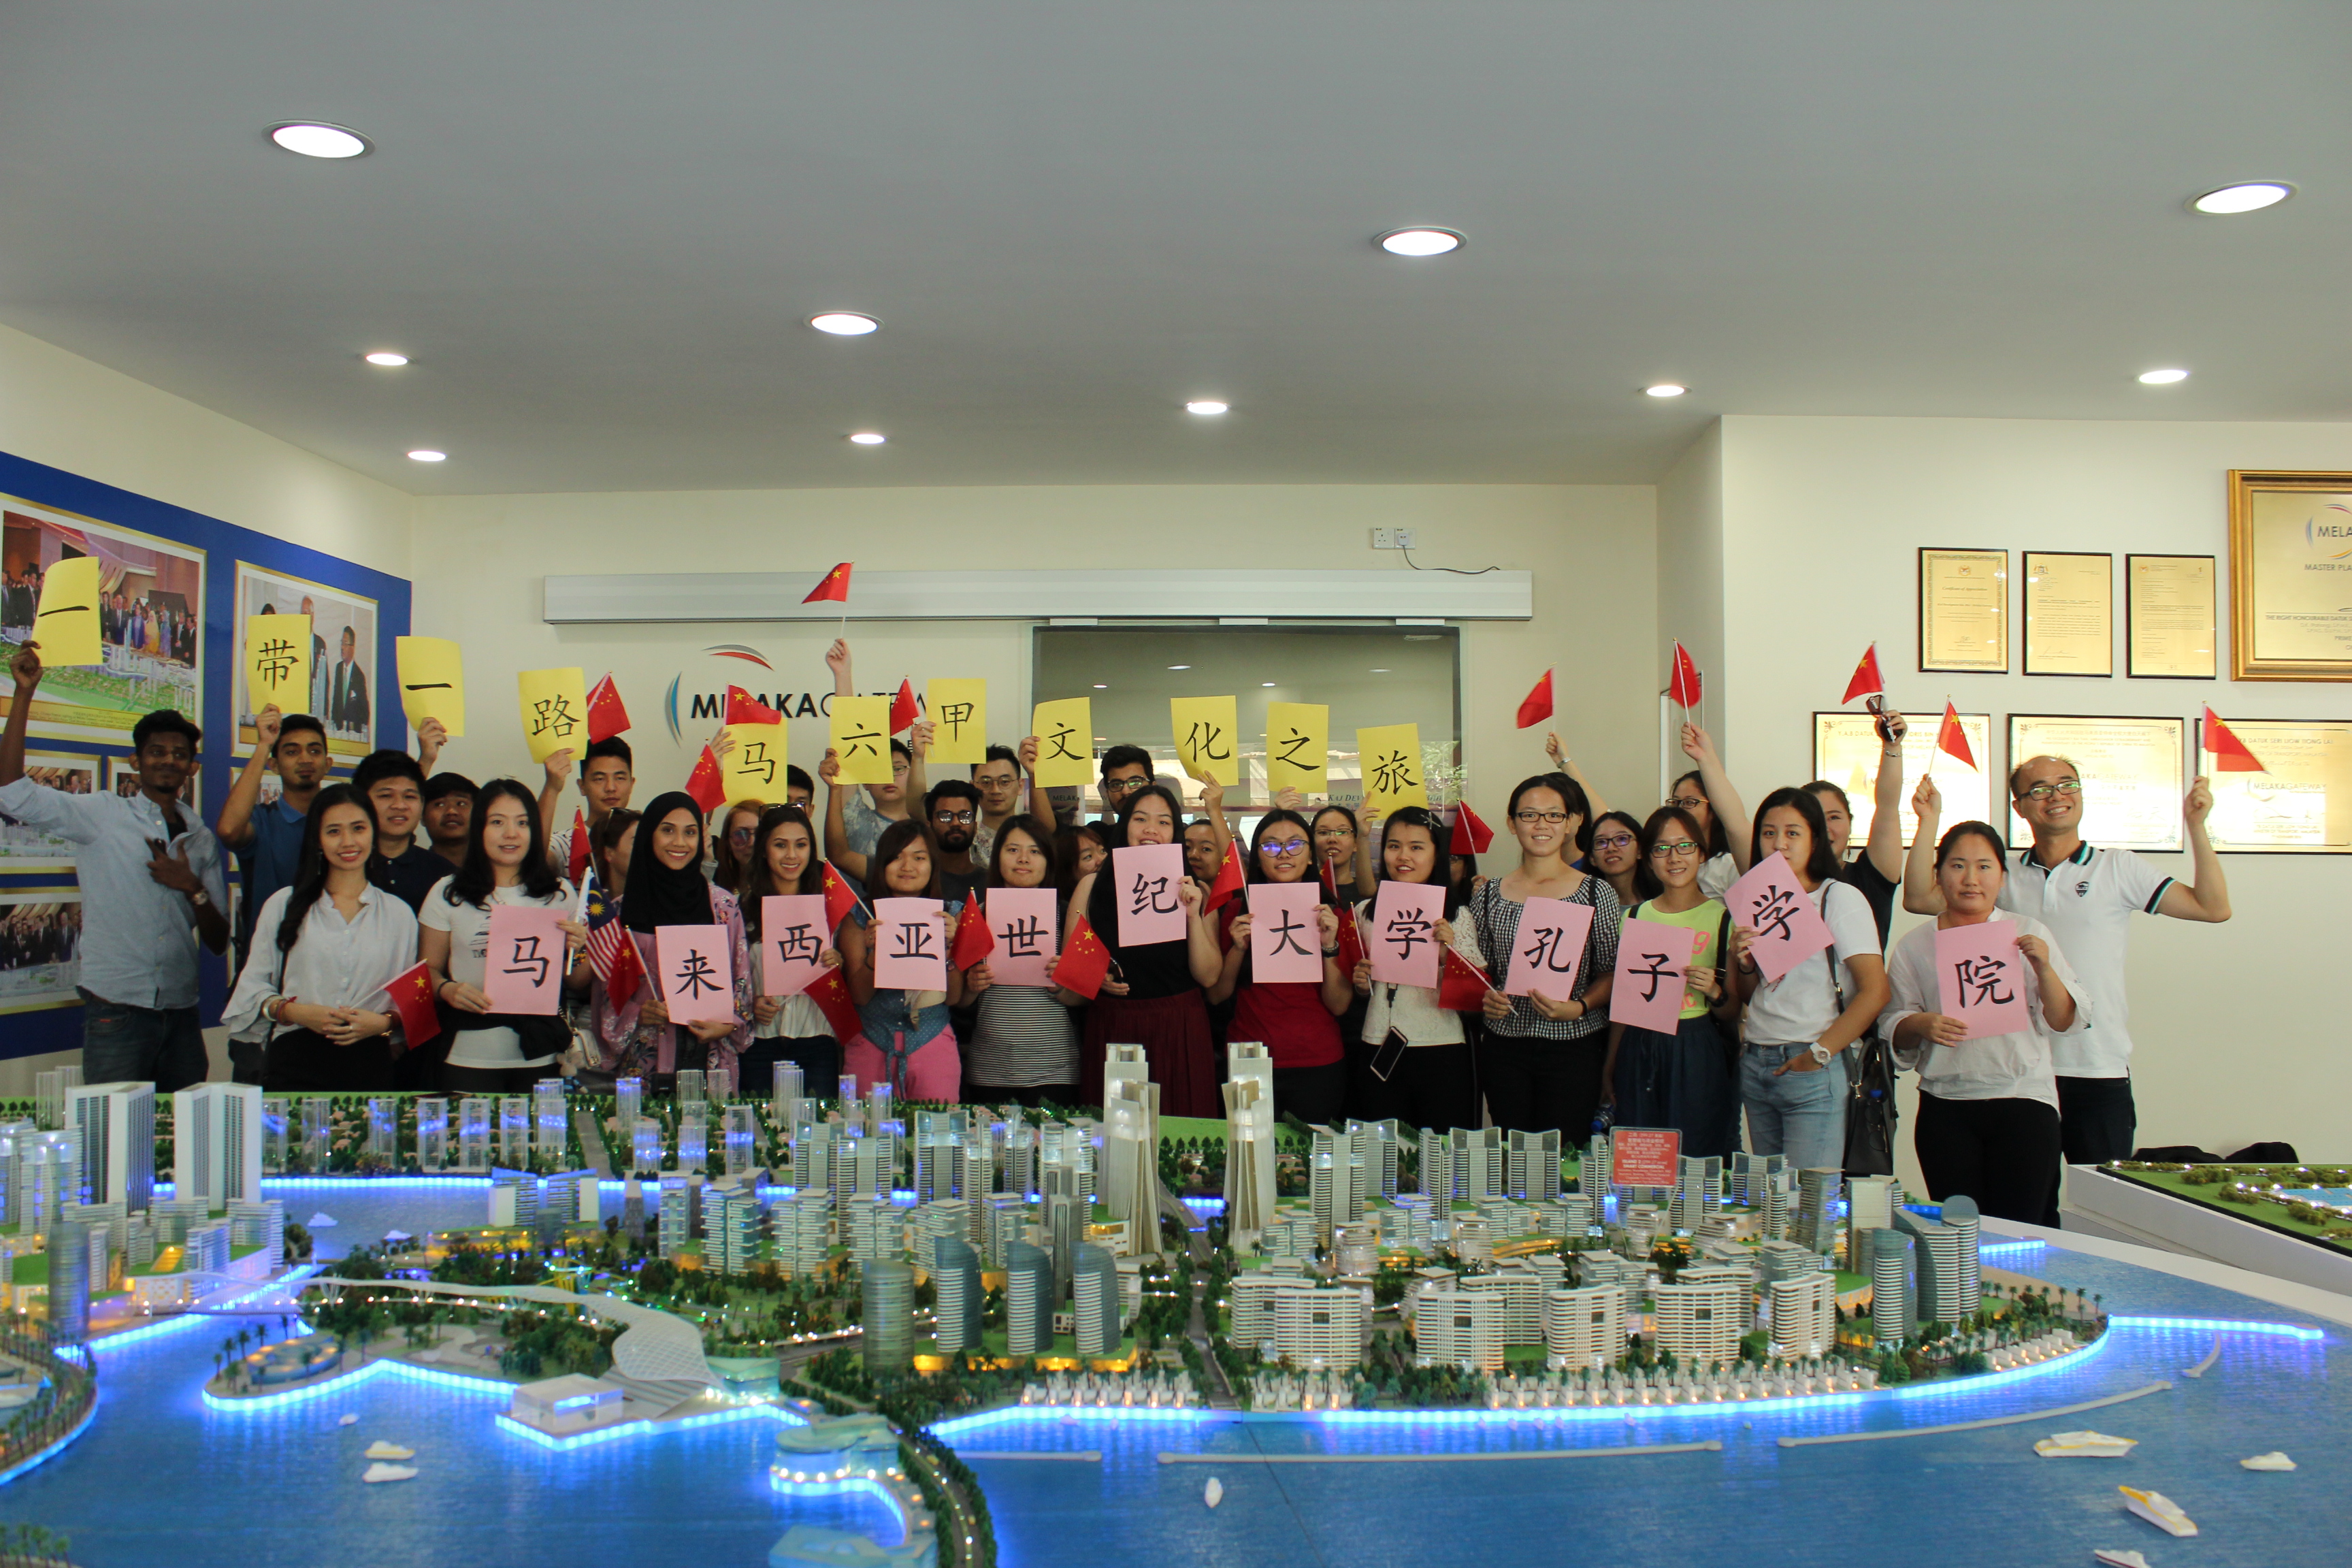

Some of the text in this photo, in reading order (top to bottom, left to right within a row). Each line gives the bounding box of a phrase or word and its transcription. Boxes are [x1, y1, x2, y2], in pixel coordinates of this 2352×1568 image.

[39, 605, 89, 617] 一
[257, 638, 299, 690] 带
[406, 683, 452, 691] 一
[532, 694, 579, 738] 路
[941, 702, 975, 742] 甲
[840, 723, 881, 758] 六
[1046, 722, 1085, 761] 文
[1185, 721, 1230, 763] 化
[1275, 728, 1320, 771] 之
[737, 742, 776, 785] 马
[1371, 750, 1418, 795] 旅
[1131, 873, 1179, 915] 纪
[1753, 885, 1800, 941] 学
[777, 924, 823, 967] 西
[889, 922, 938, 960] 亚
[997, 915, 1049, 958] 世
[1269, 909, 1313, 956] 大
[1386, 907, 1433, 961] 学
[1524, 927, 1571, 973] 孔
[1688, 928, 1711, 955] 9
[503, 936, 550, 988] 马
[675, 949, 724, 1000] 来
[1627, 953, 1680, 1002] 子
[1954, 956, 2015, 1009] 院
